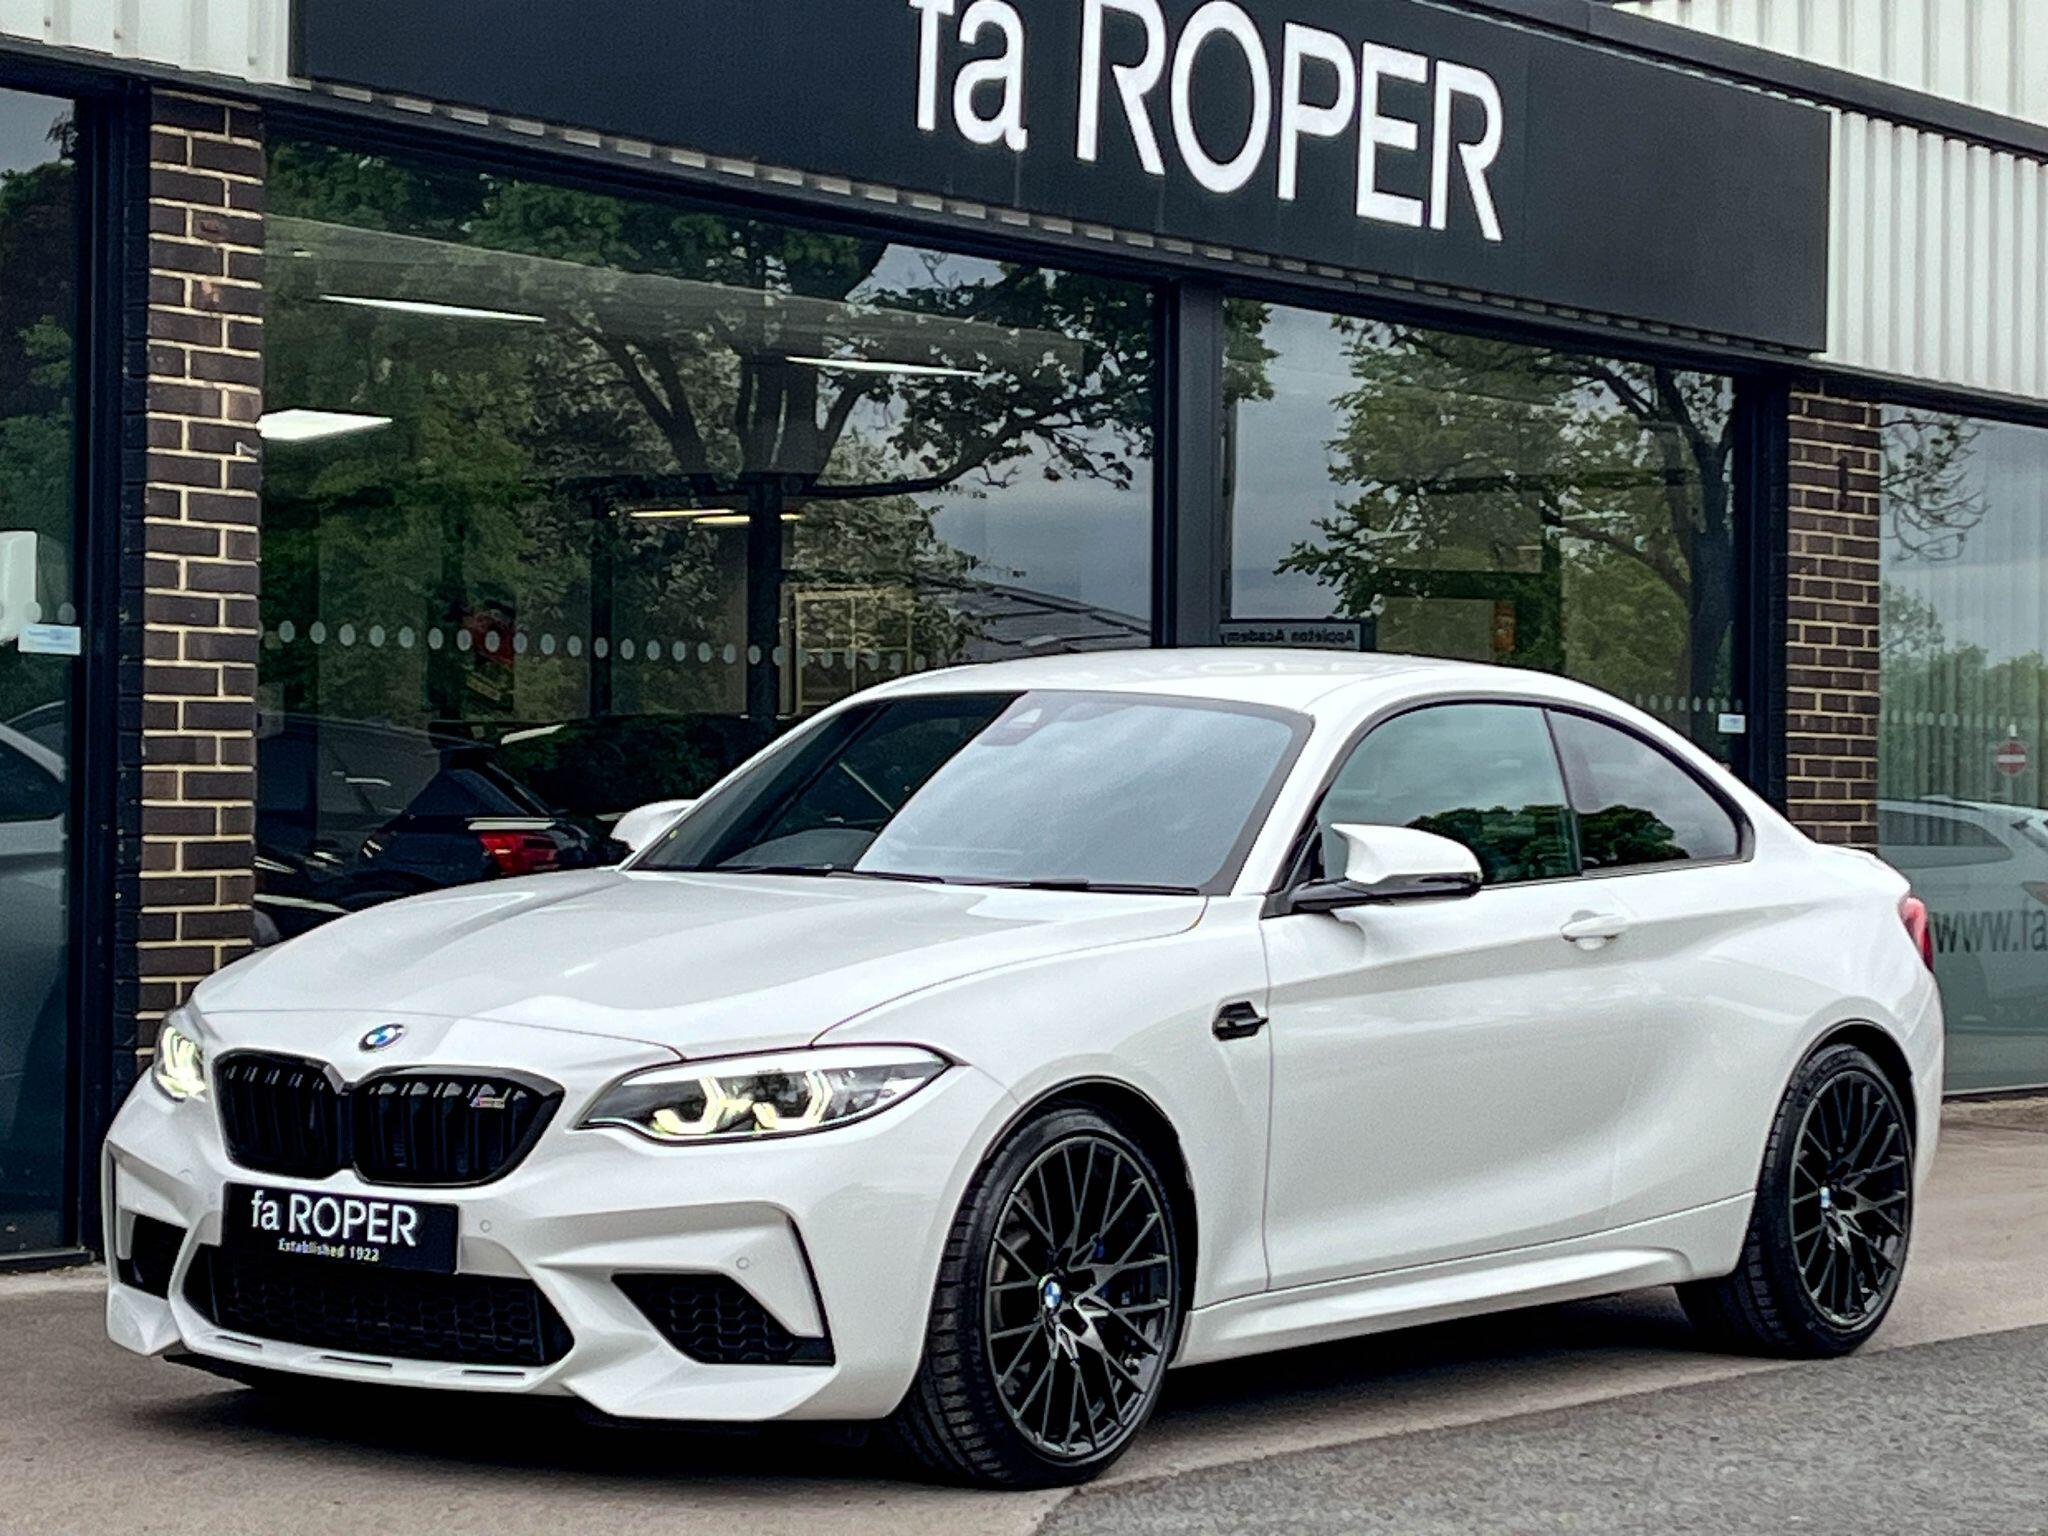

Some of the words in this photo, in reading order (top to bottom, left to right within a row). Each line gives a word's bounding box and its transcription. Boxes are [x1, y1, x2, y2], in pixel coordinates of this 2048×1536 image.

[908, 0, 1029, 152] fa
[1076, 0, 1503, 242] ROPER
[251, 1190, 281, 1231] fa
[289, 1193, 417, 1247] ROPER
[278, 1238, 346, 1259] Established
[349, 1244, 380, 1262] 1922
